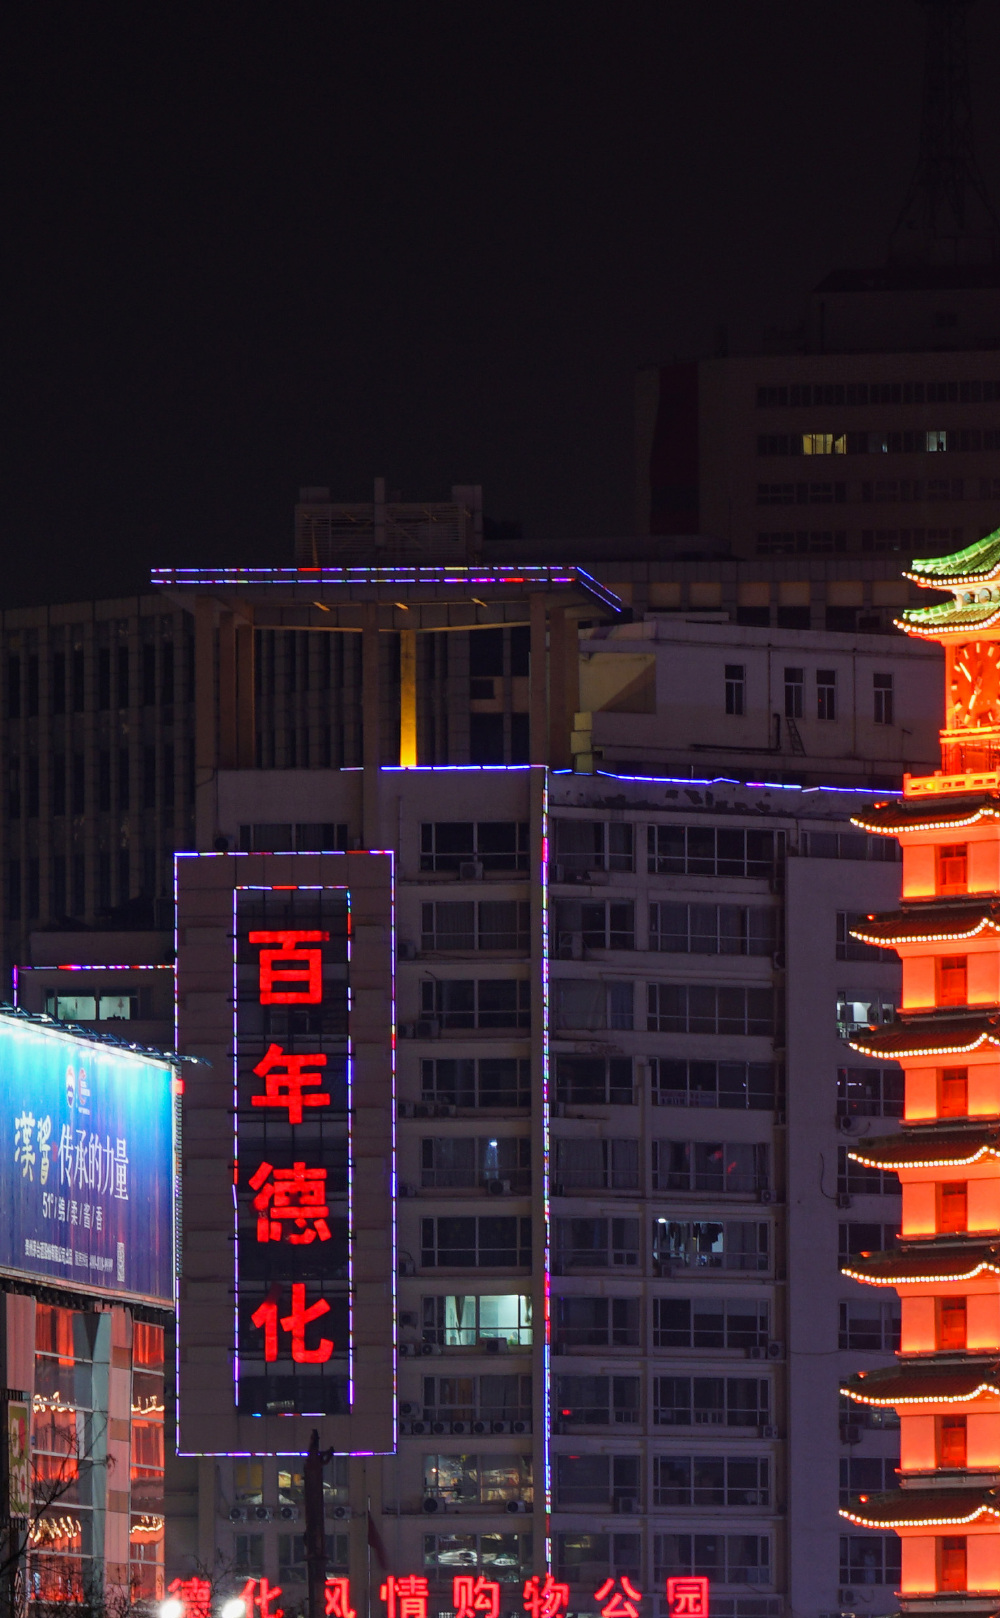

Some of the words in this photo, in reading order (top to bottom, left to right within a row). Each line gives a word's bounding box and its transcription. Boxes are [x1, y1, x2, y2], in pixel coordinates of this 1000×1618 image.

[58, 1123, 129, 1200] 传承的力量
[249, 931, 334, 1363] 百年德化
